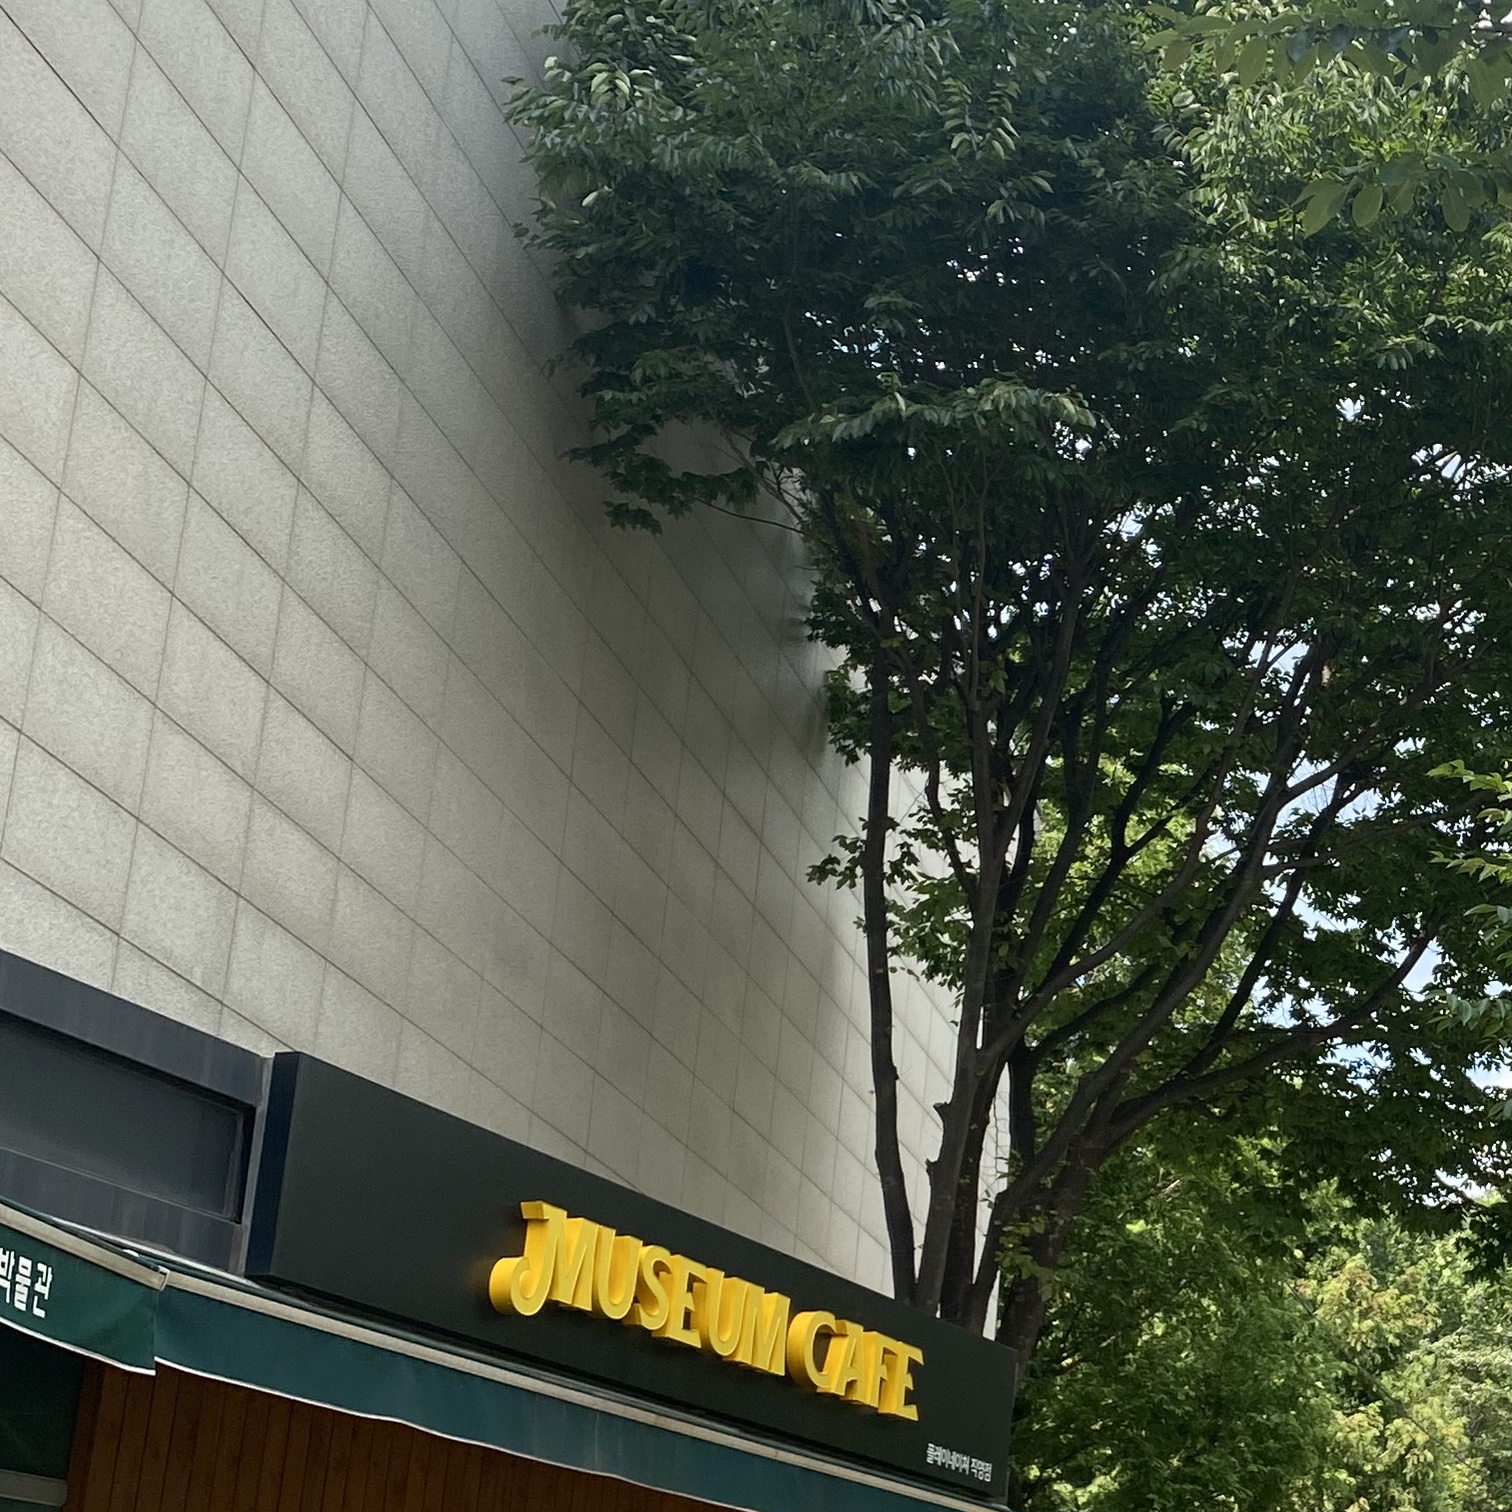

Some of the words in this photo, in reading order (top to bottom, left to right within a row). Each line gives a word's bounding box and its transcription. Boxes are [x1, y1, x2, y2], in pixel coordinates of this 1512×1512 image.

[0, 1247, 53, 1319] 박물관
[489, 1201, 791, 1376] MUSEUM
[786, 1310, 924, 1421] CAFE
[970, 1457, 993, 1482] 직영점
